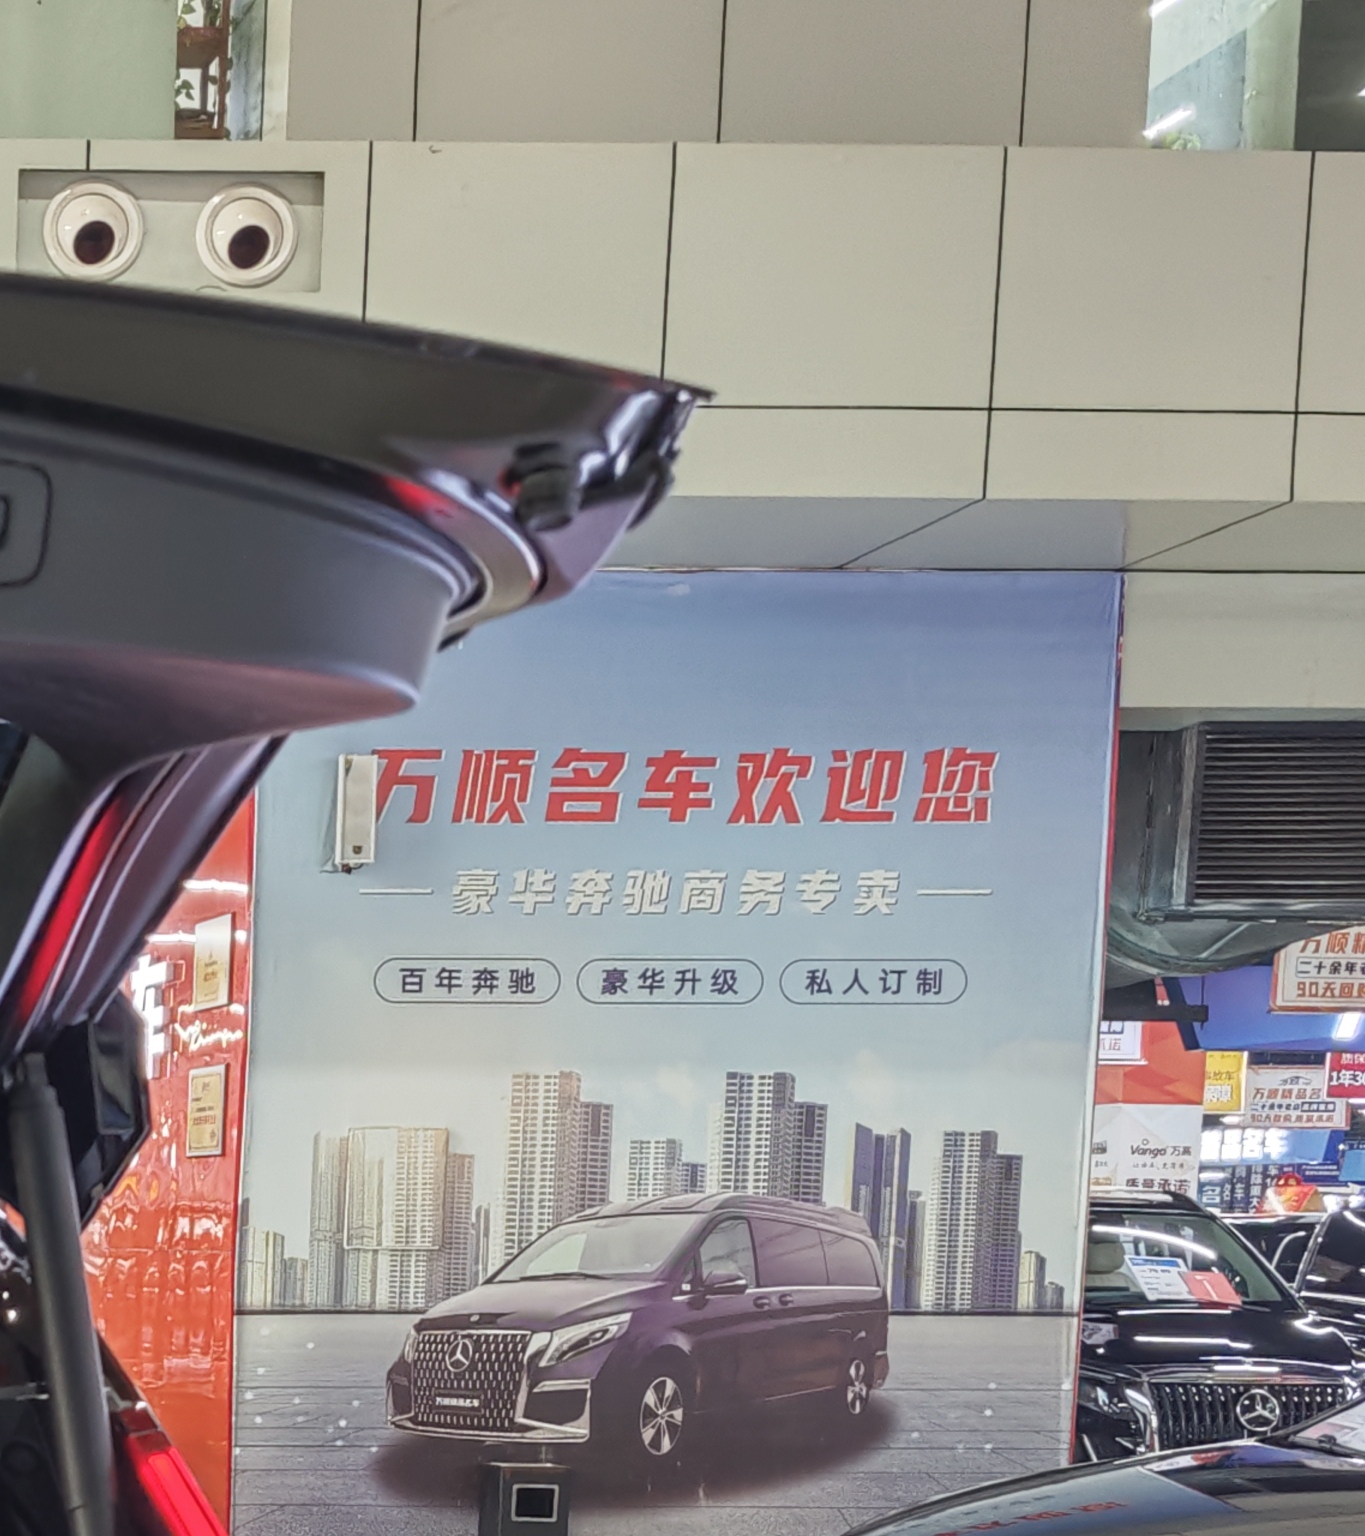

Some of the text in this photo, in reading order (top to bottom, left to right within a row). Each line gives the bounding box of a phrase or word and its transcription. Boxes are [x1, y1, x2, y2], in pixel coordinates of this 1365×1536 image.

[373, 747, 1000, 824] 万顺名车欢迎您
[450, 868, 901, 917] 豪华奔驰商务专卖
[398, 967, 945, 996] 百年奔驰 豪华升级 私人订制
[1297, 960, 1365, 975] 二十余年
